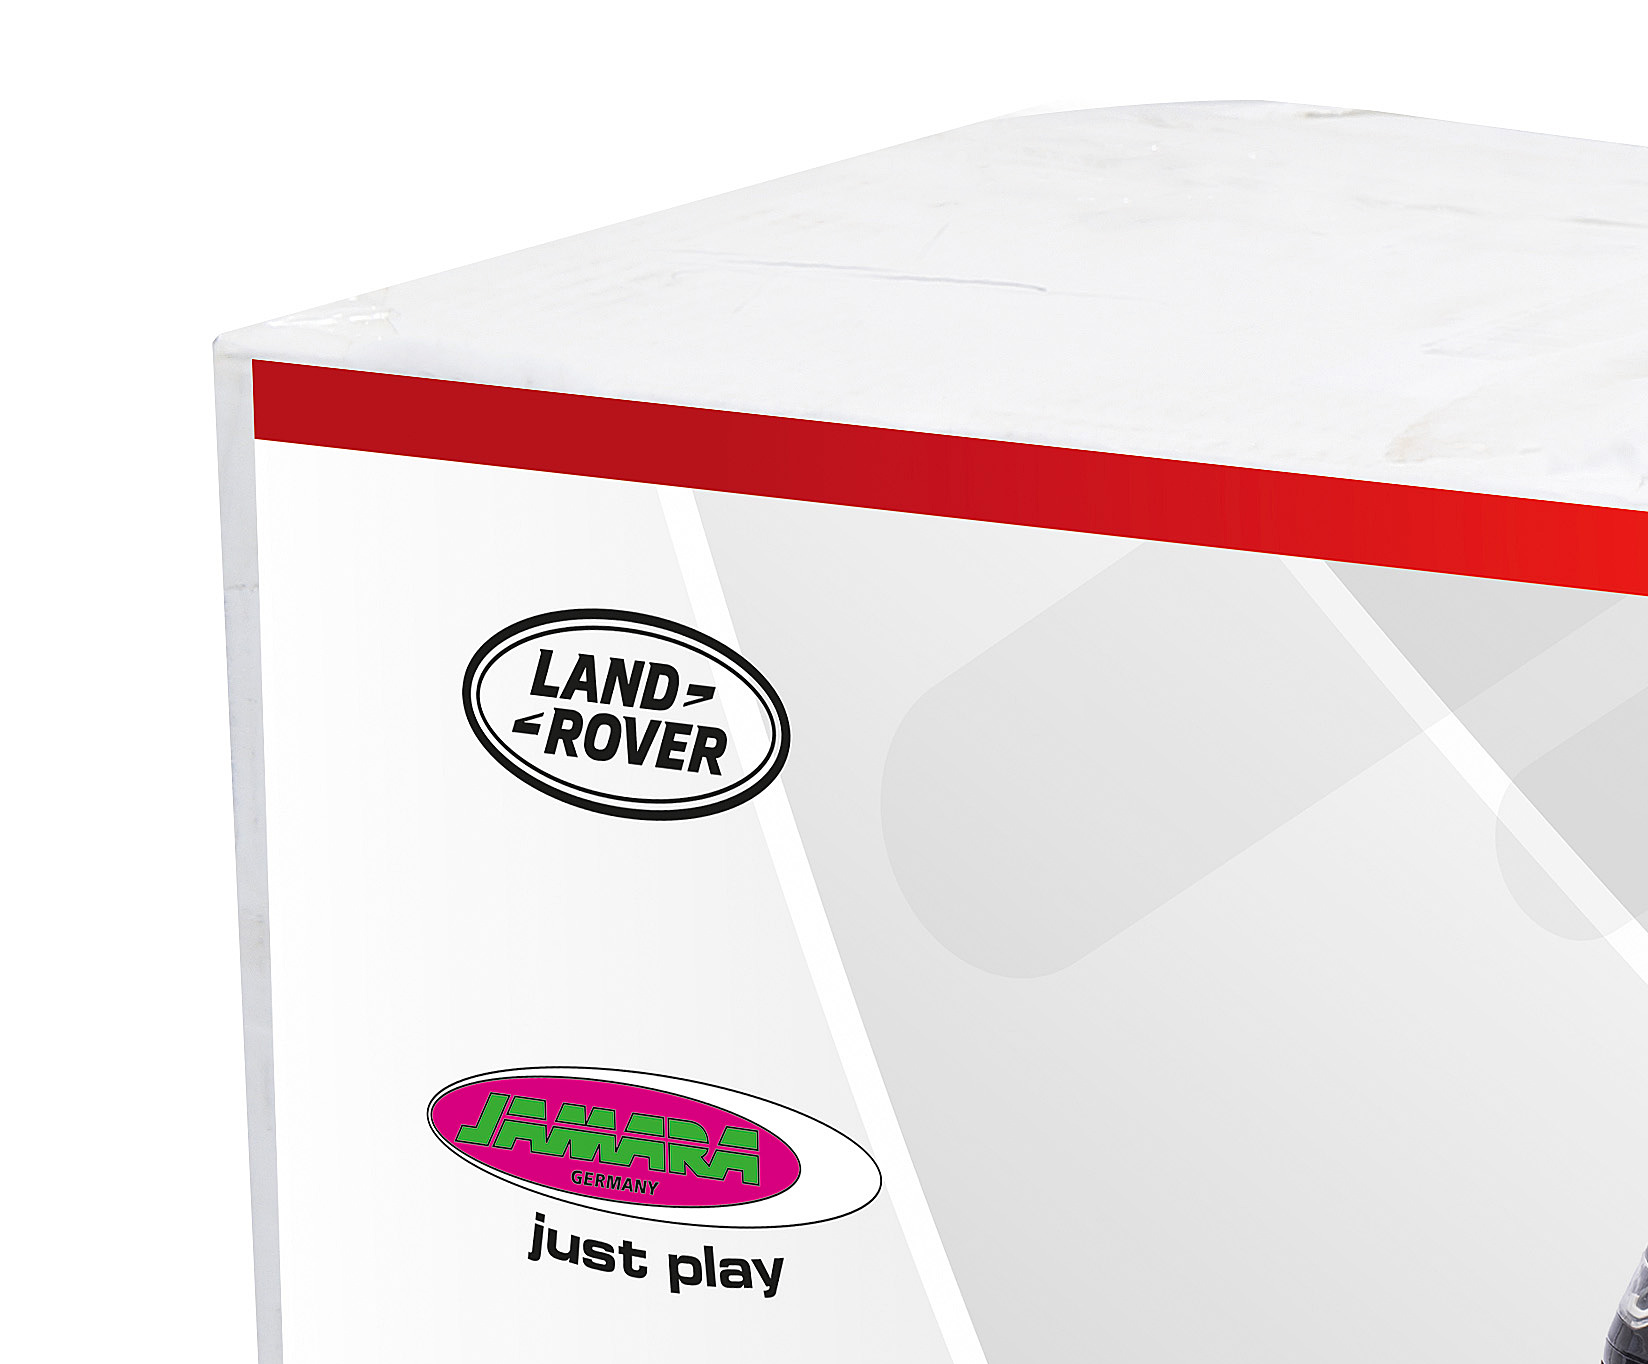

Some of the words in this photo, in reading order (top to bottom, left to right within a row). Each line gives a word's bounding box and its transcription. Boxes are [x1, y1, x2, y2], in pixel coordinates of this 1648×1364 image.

[530, 648, 680, 711] LAND
[544, 711, 728, 776] ROVER
[455, 1091, 761, 1186] JAMARA
[571, 1171, 660, 1196] GERMANY
[528, 1212, 648, 1278] just
[668, 1245, 785, 1299] play
